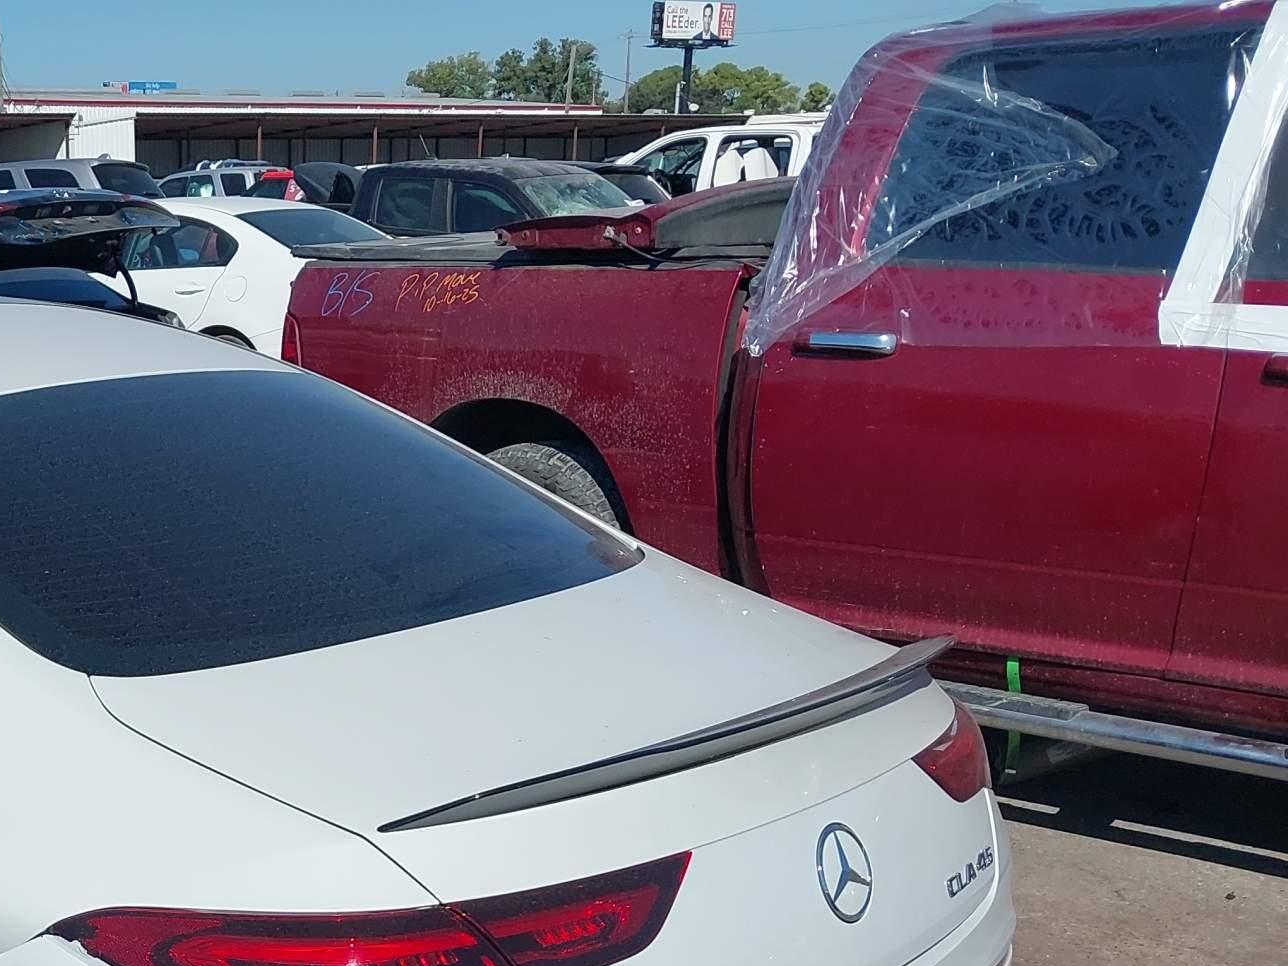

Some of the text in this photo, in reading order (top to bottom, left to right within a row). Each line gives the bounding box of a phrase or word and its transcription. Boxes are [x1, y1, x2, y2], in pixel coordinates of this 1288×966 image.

[666, 5, 679, 14] Call
[721, 21, 733, 29] CALL
[719, 28, 733, 39] LEE
[946, 846, 994, 898] CLA 45
